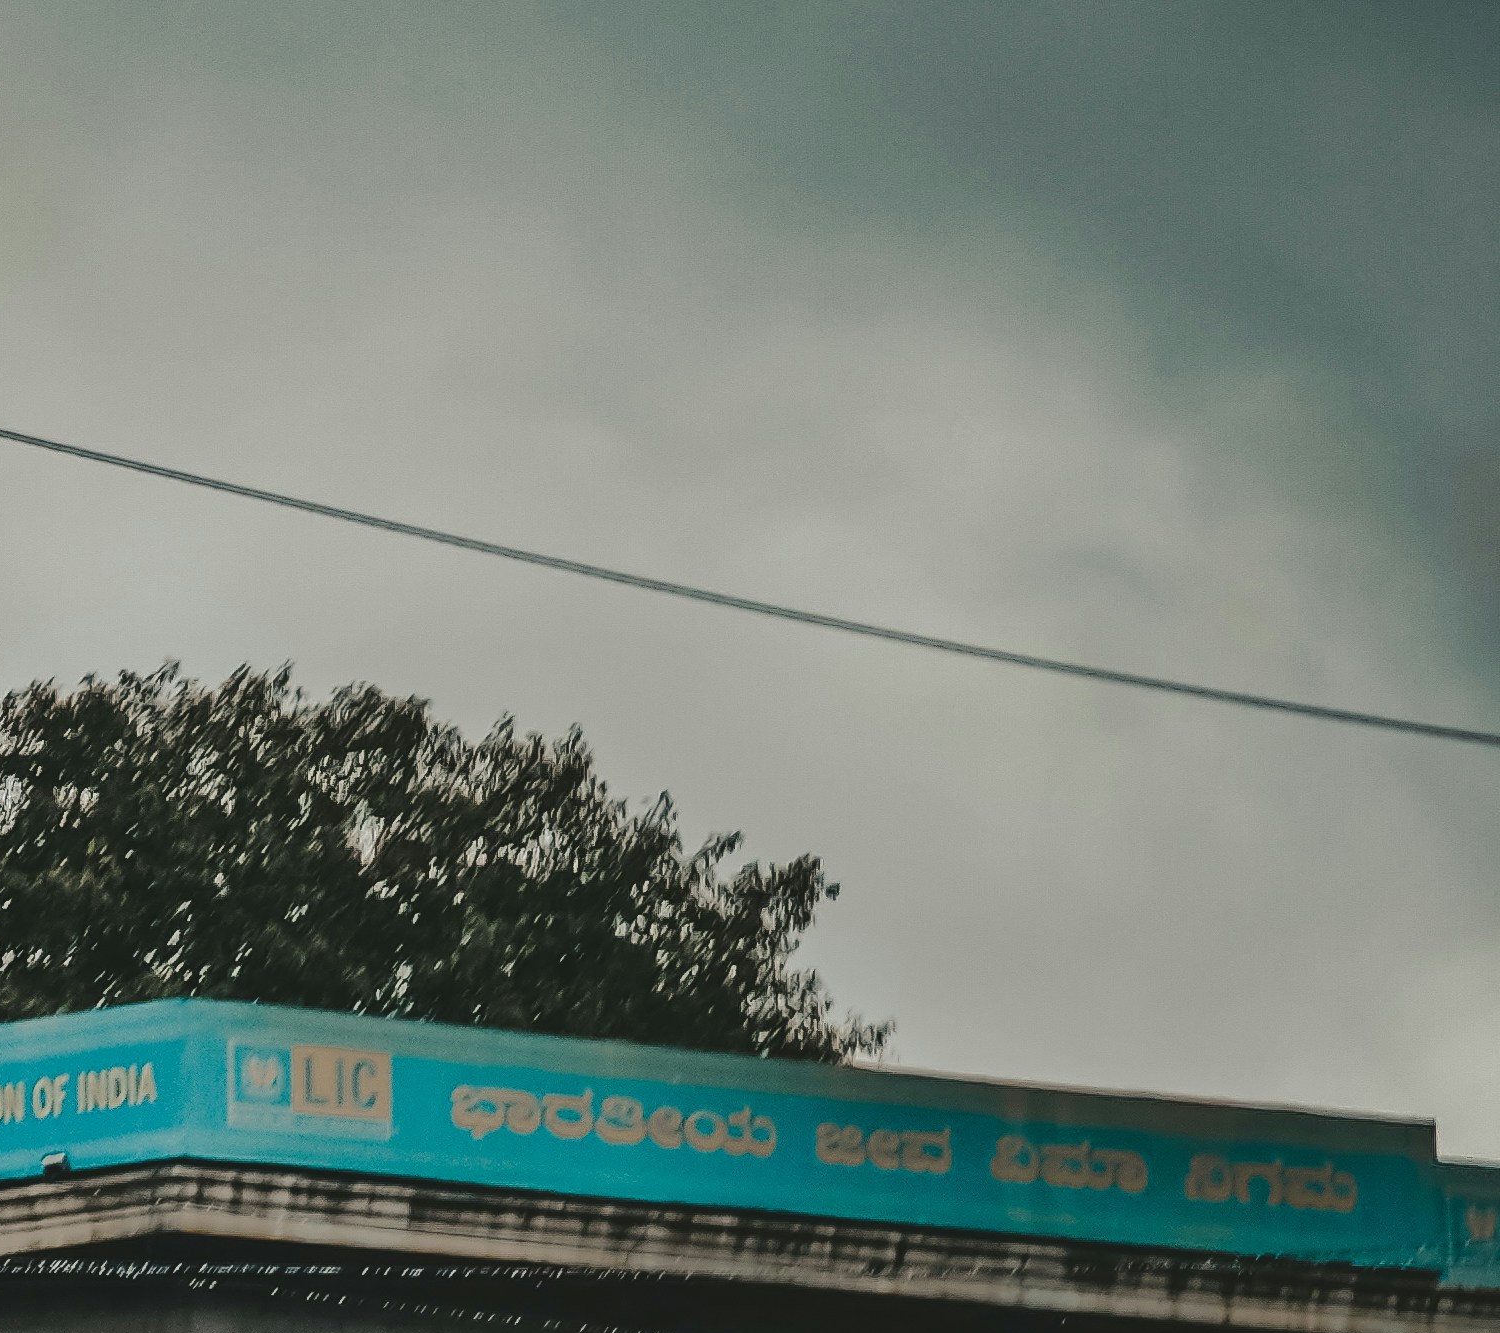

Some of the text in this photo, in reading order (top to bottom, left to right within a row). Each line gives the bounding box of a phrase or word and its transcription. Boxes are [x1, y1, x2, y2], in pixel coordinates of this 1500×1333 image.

[32, 1075, 70, 1120] OF
[76, 1061, 157, 1115] INDIA
[304, 1054, 379, 1110] LIC
[450, 1084, 778, 1158] ಭಾರತೀಯ
[1184, 1152, 1358, 1213] ನಿಗಮ
